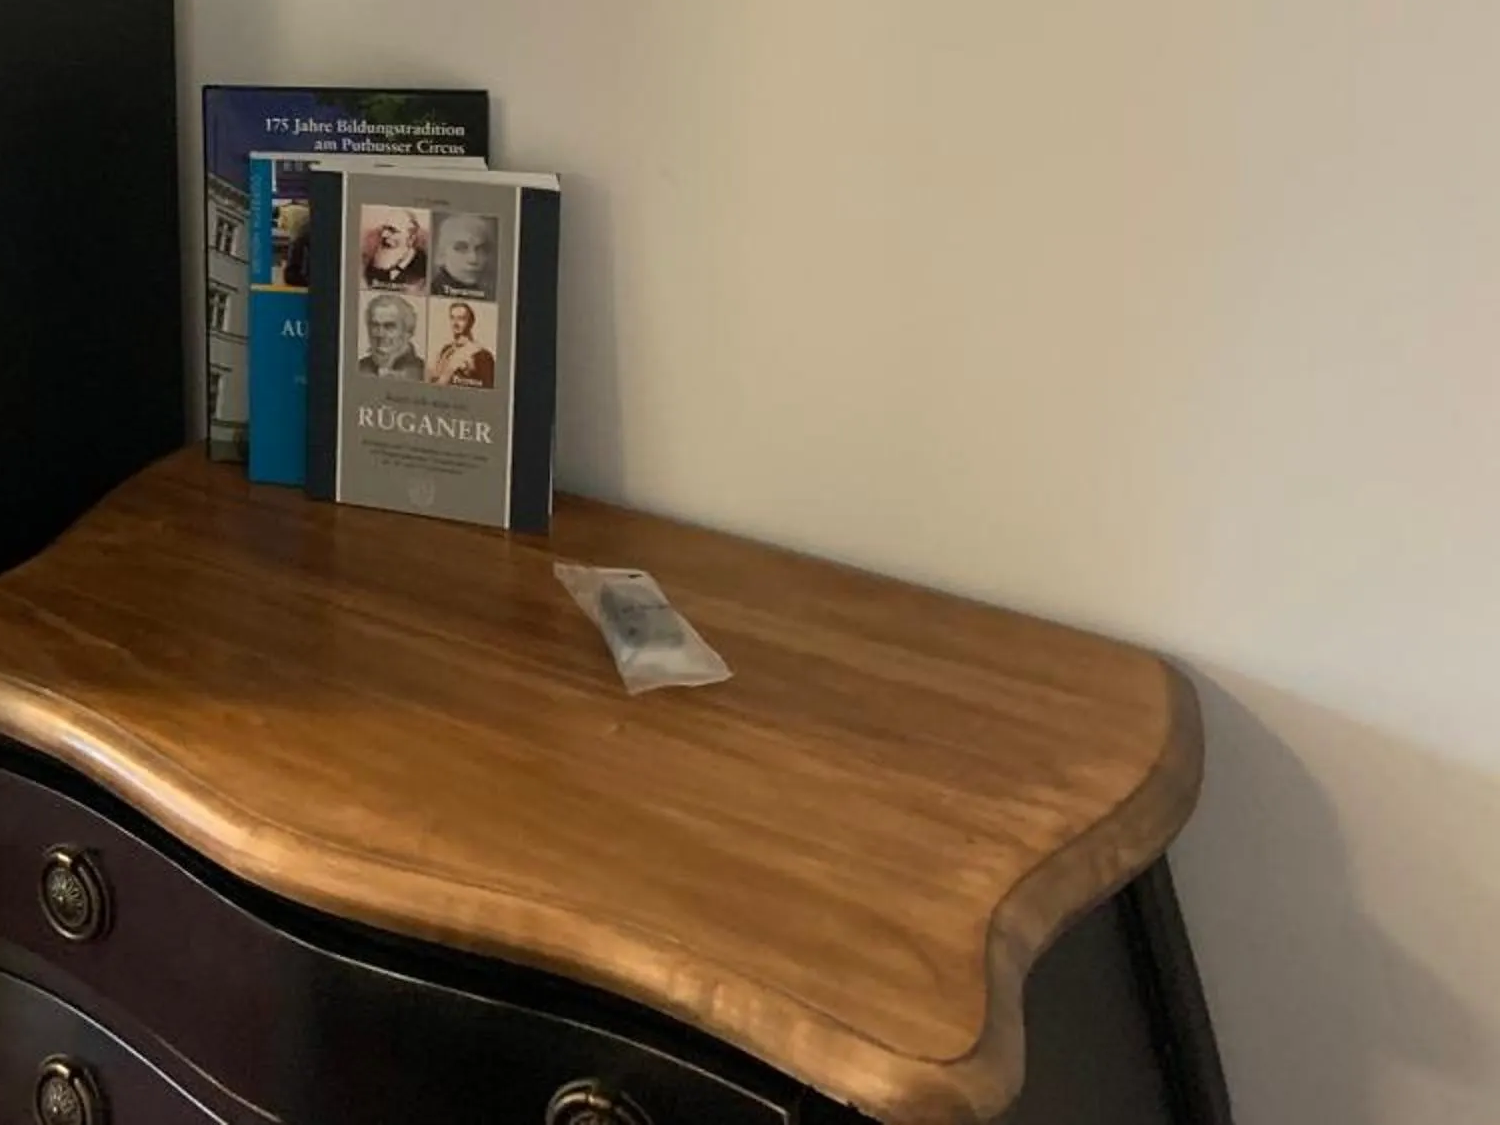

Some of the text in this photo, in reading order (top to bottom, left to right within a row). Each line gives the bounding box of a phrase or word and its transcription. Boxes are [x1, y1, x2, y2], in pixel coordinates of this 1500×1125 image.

[264, 117, 466, 137] 175 Jahre Bildungstradition
[313, 140, 337, 151] am
[416, 140, 466, 155] Circus
[357, 405, 494, 443] RÜGANER
